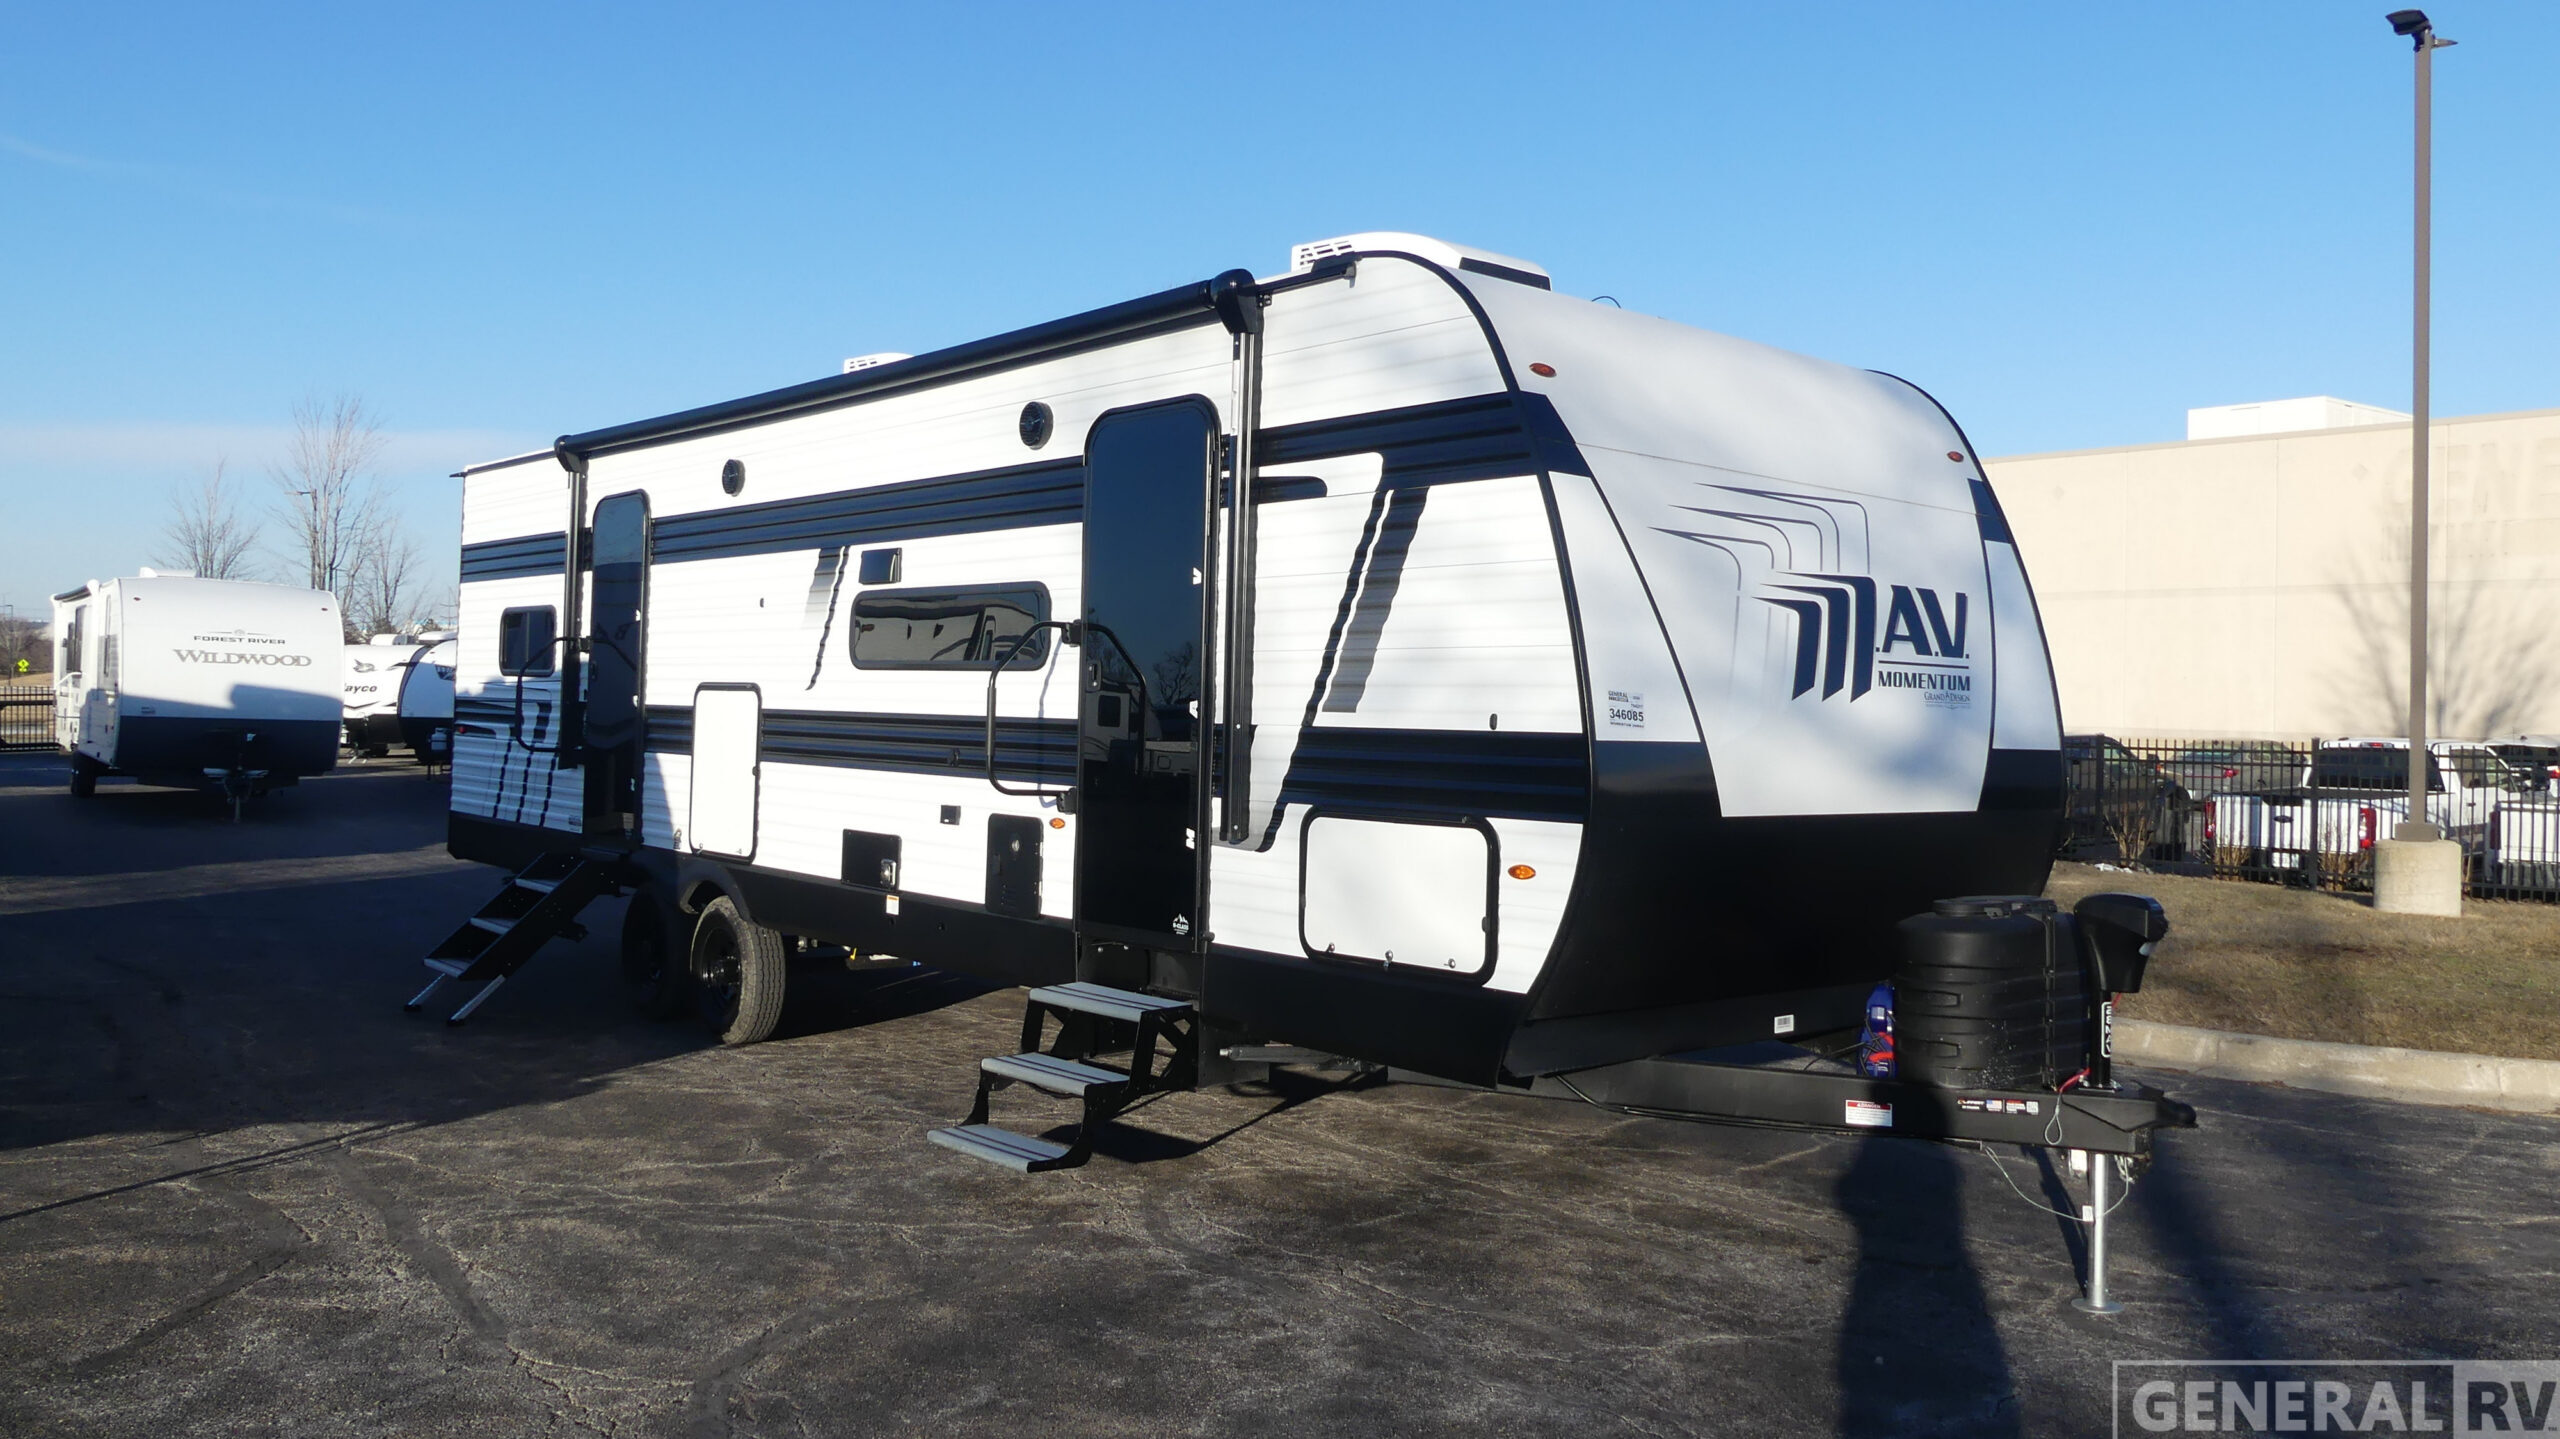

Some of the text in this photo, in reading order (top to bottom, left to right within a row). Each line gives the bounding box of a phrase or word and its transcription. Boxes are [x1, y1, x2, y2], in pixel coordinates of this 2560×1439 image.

[193, 635, 244, 643] FOREST
[173, 649, 312, 666] WILDWOOD
[1878, 670, 1970, 691] MOMENTUM
[344, 683, 378, 694] ayco
[1609, 708, 1643, 721] 346085
